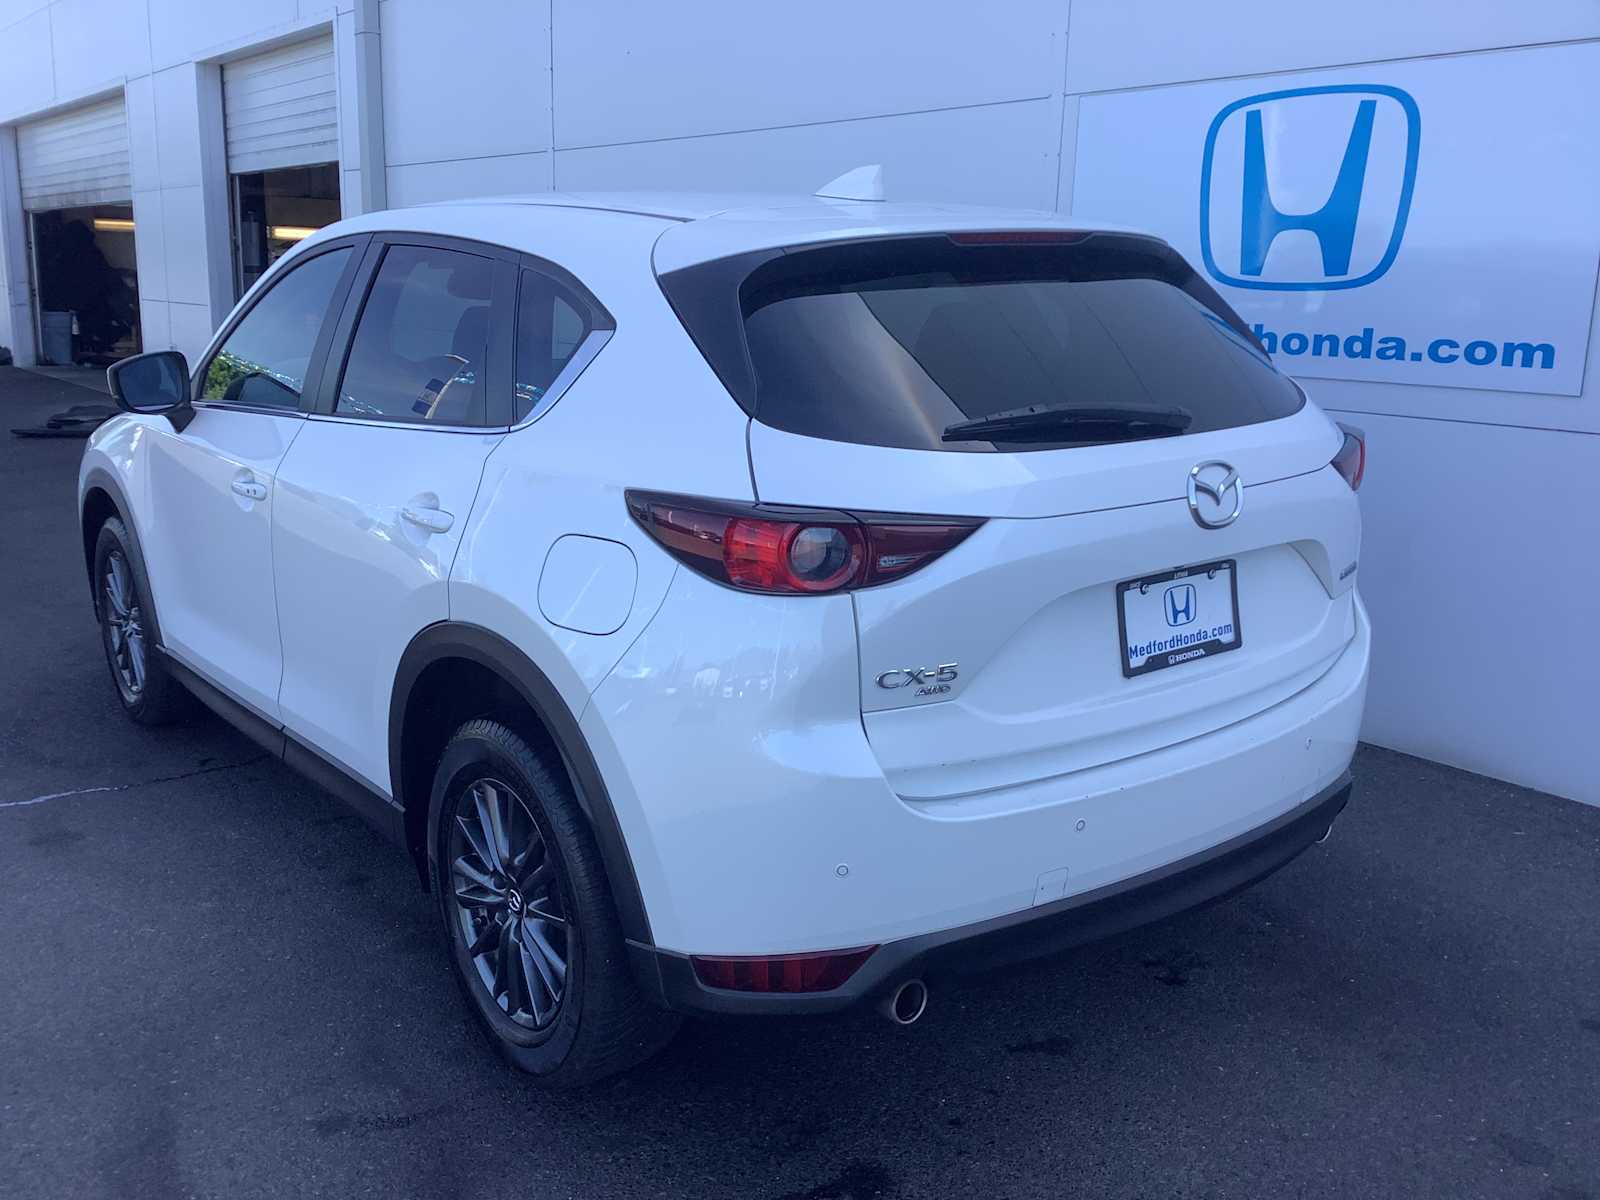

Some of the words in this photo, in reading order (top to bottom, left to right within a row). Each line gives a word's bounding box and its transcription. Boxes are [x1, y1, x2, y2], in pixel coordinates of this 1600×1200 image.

[1247, 323, 1556, 370] honda.com
[1129, 623, 1233, 659] MedfordHonda.com
[1175, 648, 1206, 662] HONDA
[876, 662, 959, 689] CX-5
[914, 684, 952, 697] AWD
